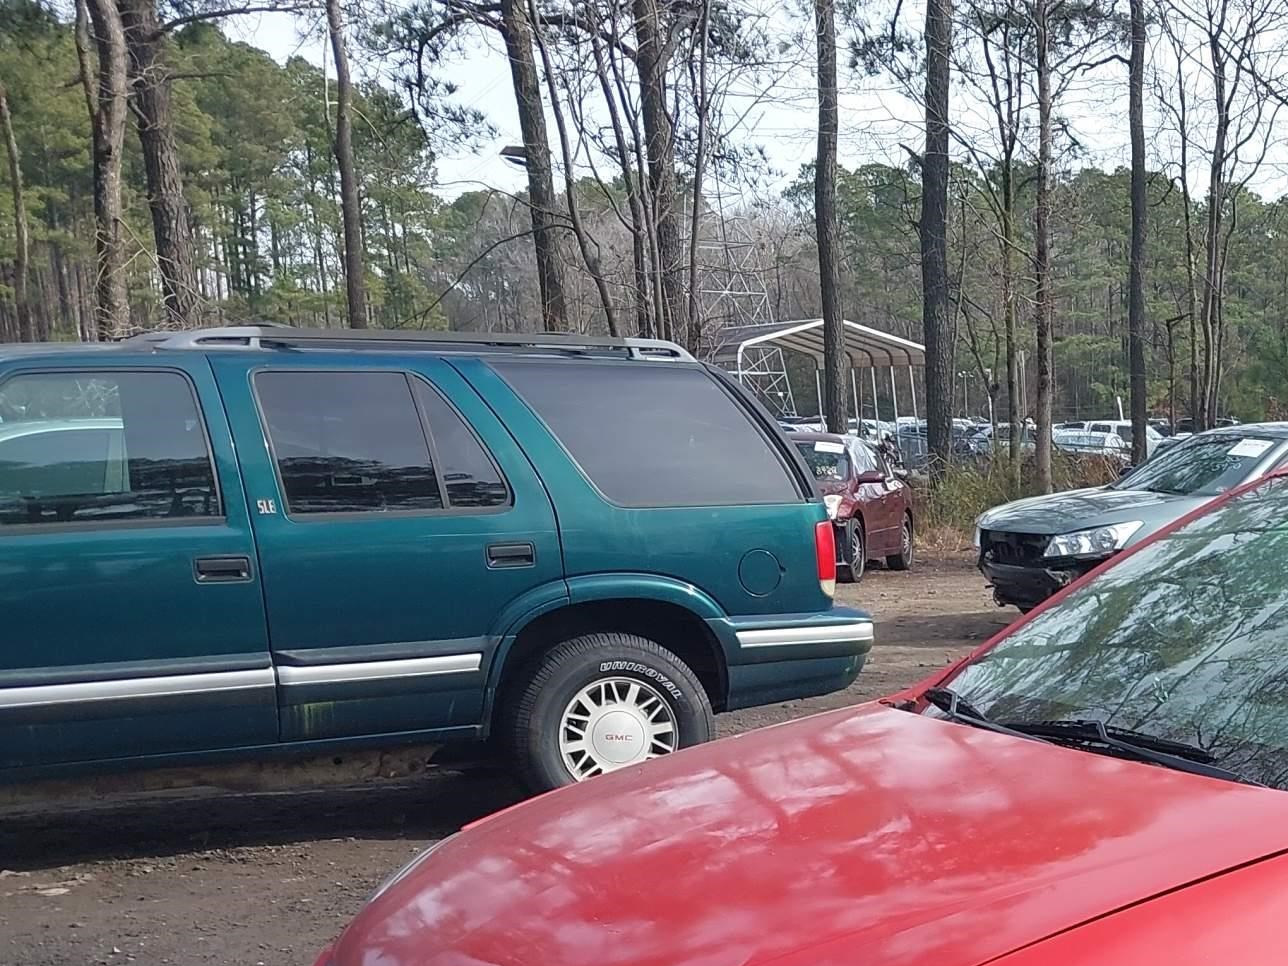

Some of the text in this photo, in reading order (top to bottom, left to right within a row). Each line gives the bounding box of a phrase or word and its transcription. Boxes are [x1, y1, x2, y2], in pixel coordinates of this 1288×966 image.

[256, 499, 276, 514] SLE
[599, 660, 683, 700] UNIROYAL
[605, 733, 633, 742] GMC
